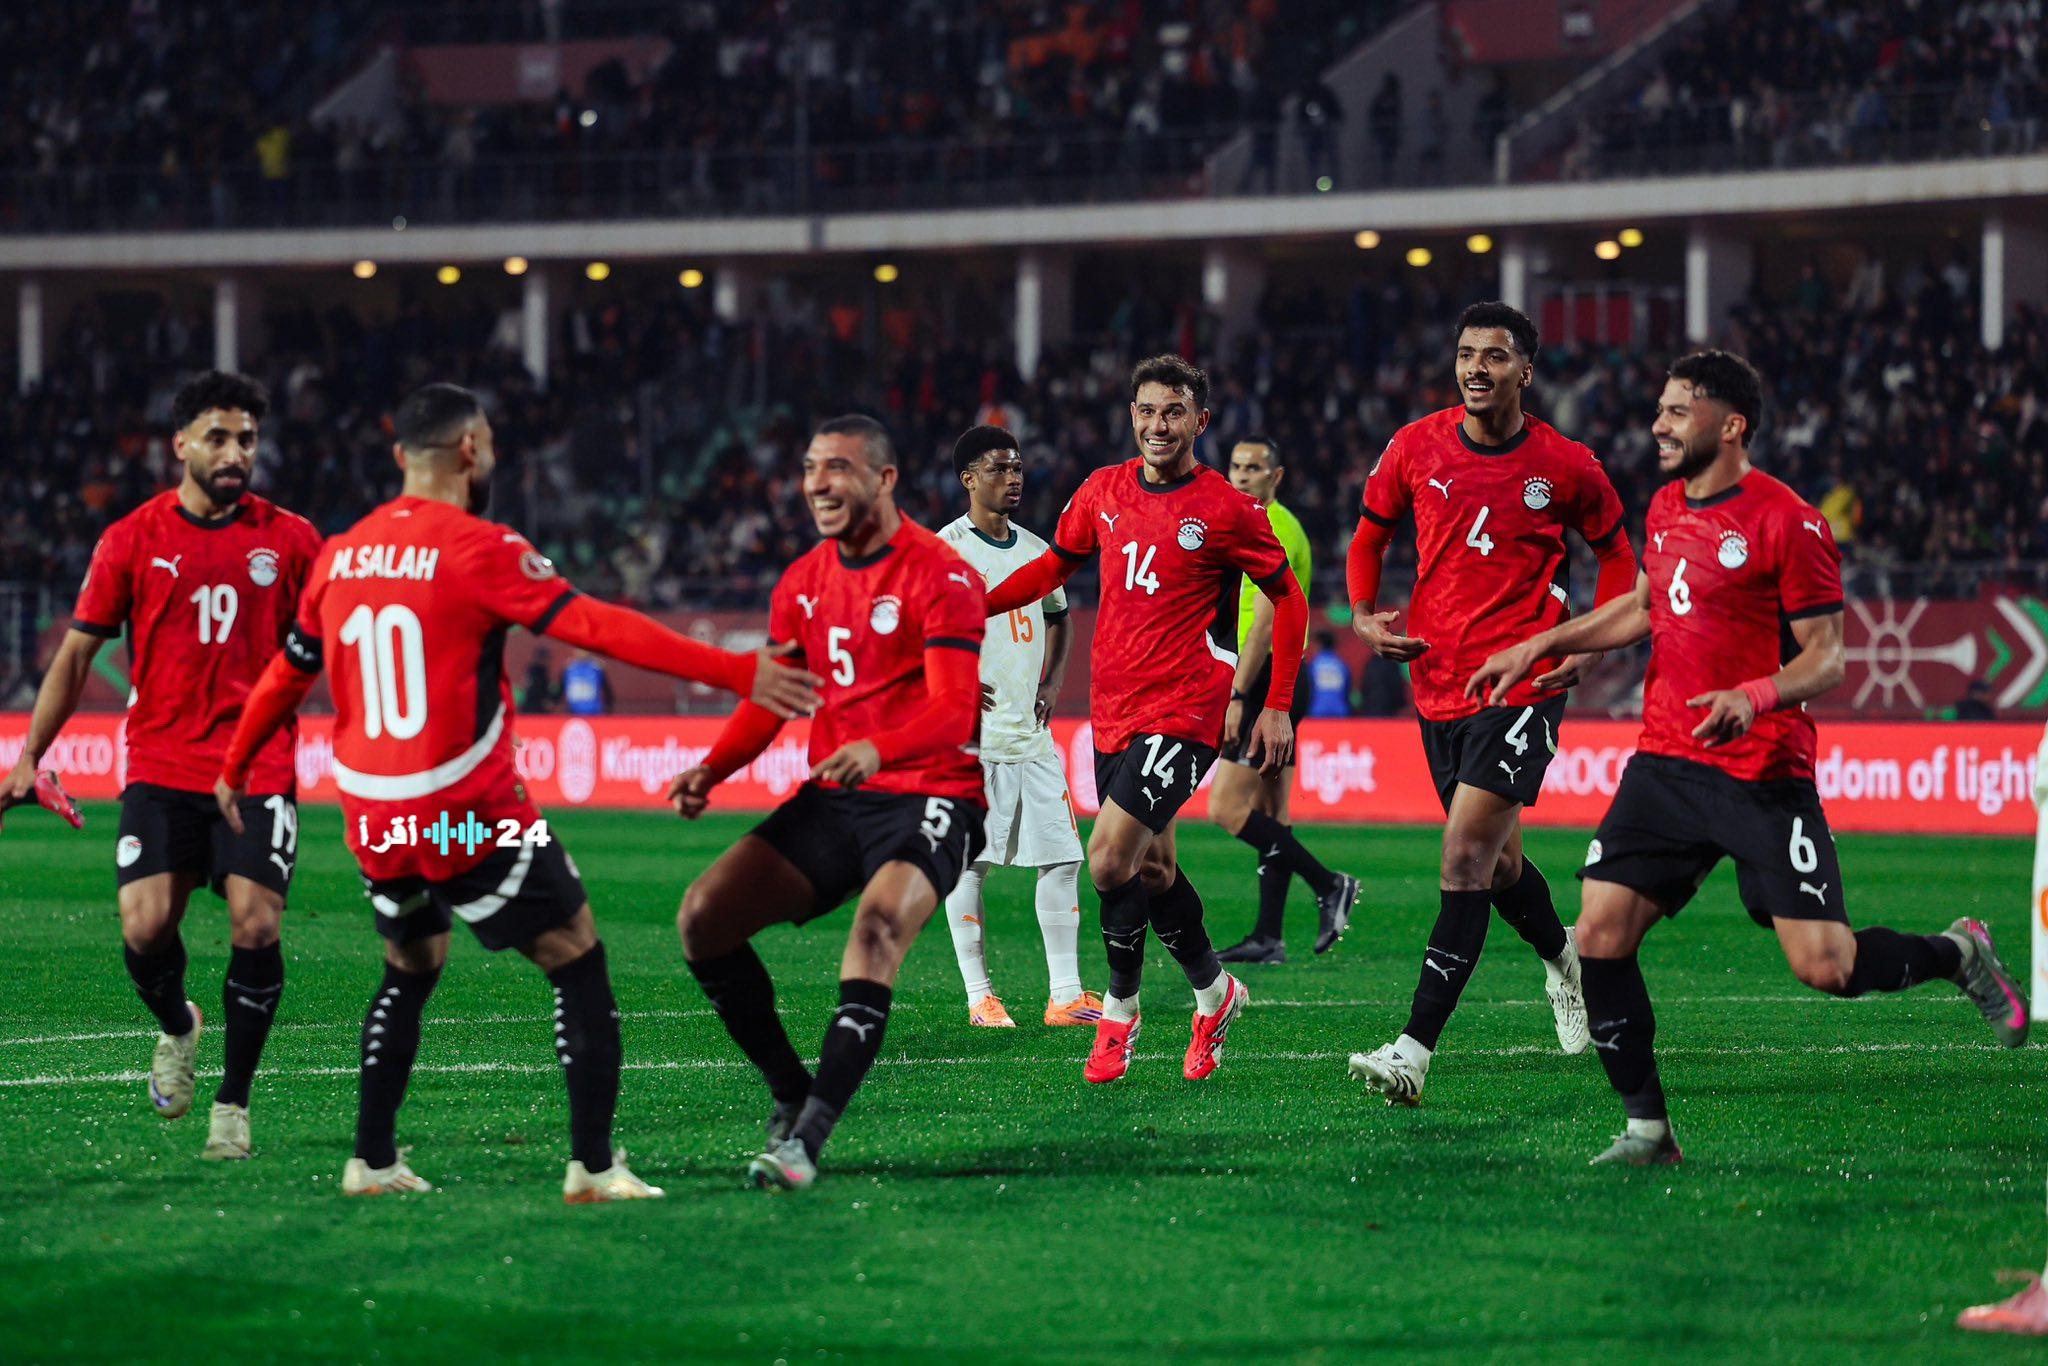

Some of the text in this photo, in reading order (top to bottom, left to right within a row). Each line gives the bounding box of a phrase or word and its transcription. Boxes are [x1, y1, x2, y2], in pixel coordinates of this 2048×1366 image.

[1466, 505, 1495, 556] 4
[328, 544, 440, 582] M.SALAH
[1121, 540, 1160, 595] 14
[1668, 556, 1692, 616] 6
[189, 583, 239, 645] 19
[1008, 607, 1034, 643] 15
[339, 603, 428, 741] 10
[828, 626, 855, 687] 5
[1504, 705, 1535, 756] 4
[1140, 734, 1183, 789] 14
[1301, 741, 1376, 804] light
[1907, 744, 1949, 801] of
[264, 794, 298, 854] 19
[920, 796, 954, 838] 5
[1789, 816, 1818, 873] 6
